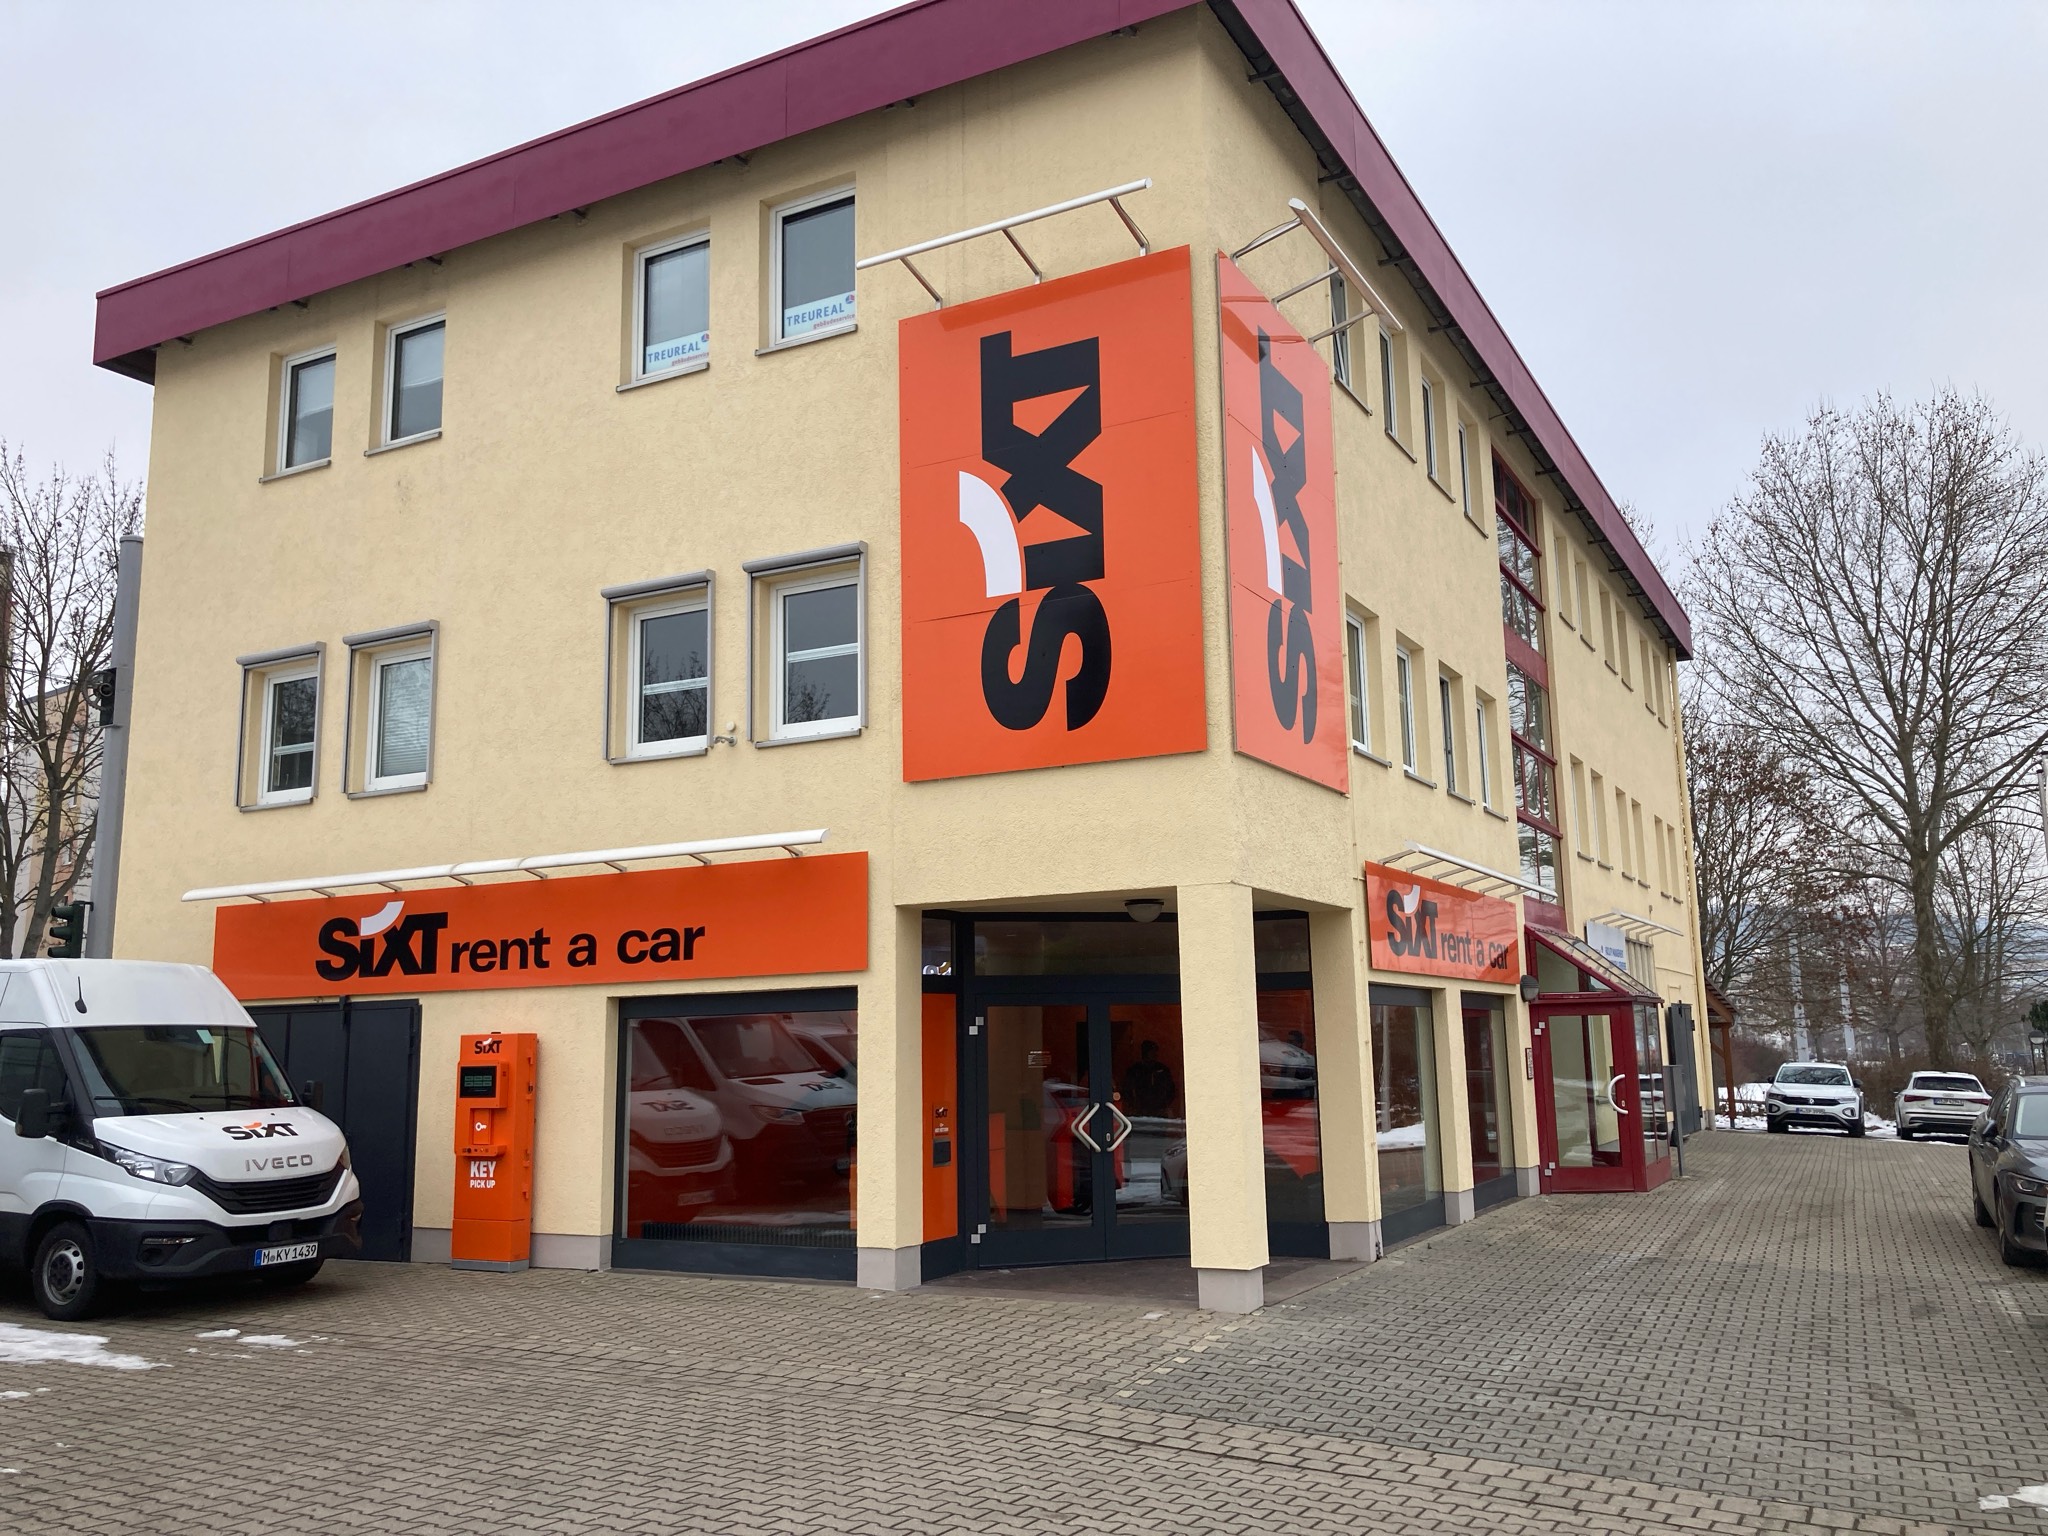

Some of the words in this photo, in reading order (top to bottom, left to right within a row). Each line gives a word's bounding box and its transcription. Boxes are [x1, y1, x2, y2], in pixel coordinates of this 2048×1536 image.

[787, 303, 844, 326] TREUREAL
[647, 341, 701, 363] TREUREAL
[450, 928, 550, 973] rent
[568, 933, 597, 967] a
[616, 925, 705, 964] car
[1441, 930, 1472, 966] rent
[1476, 939, 1485, 967] a
[1488, 941, 1509, 969] car
[246, 1154, 313, 1172] IVECO
[470, 1161, 496, 1178] KEY
[470, 1180, 486, 1188] PICK
[486, 1180, 496, 1188] UP
[292, 1245, 316, 1258] 1439
